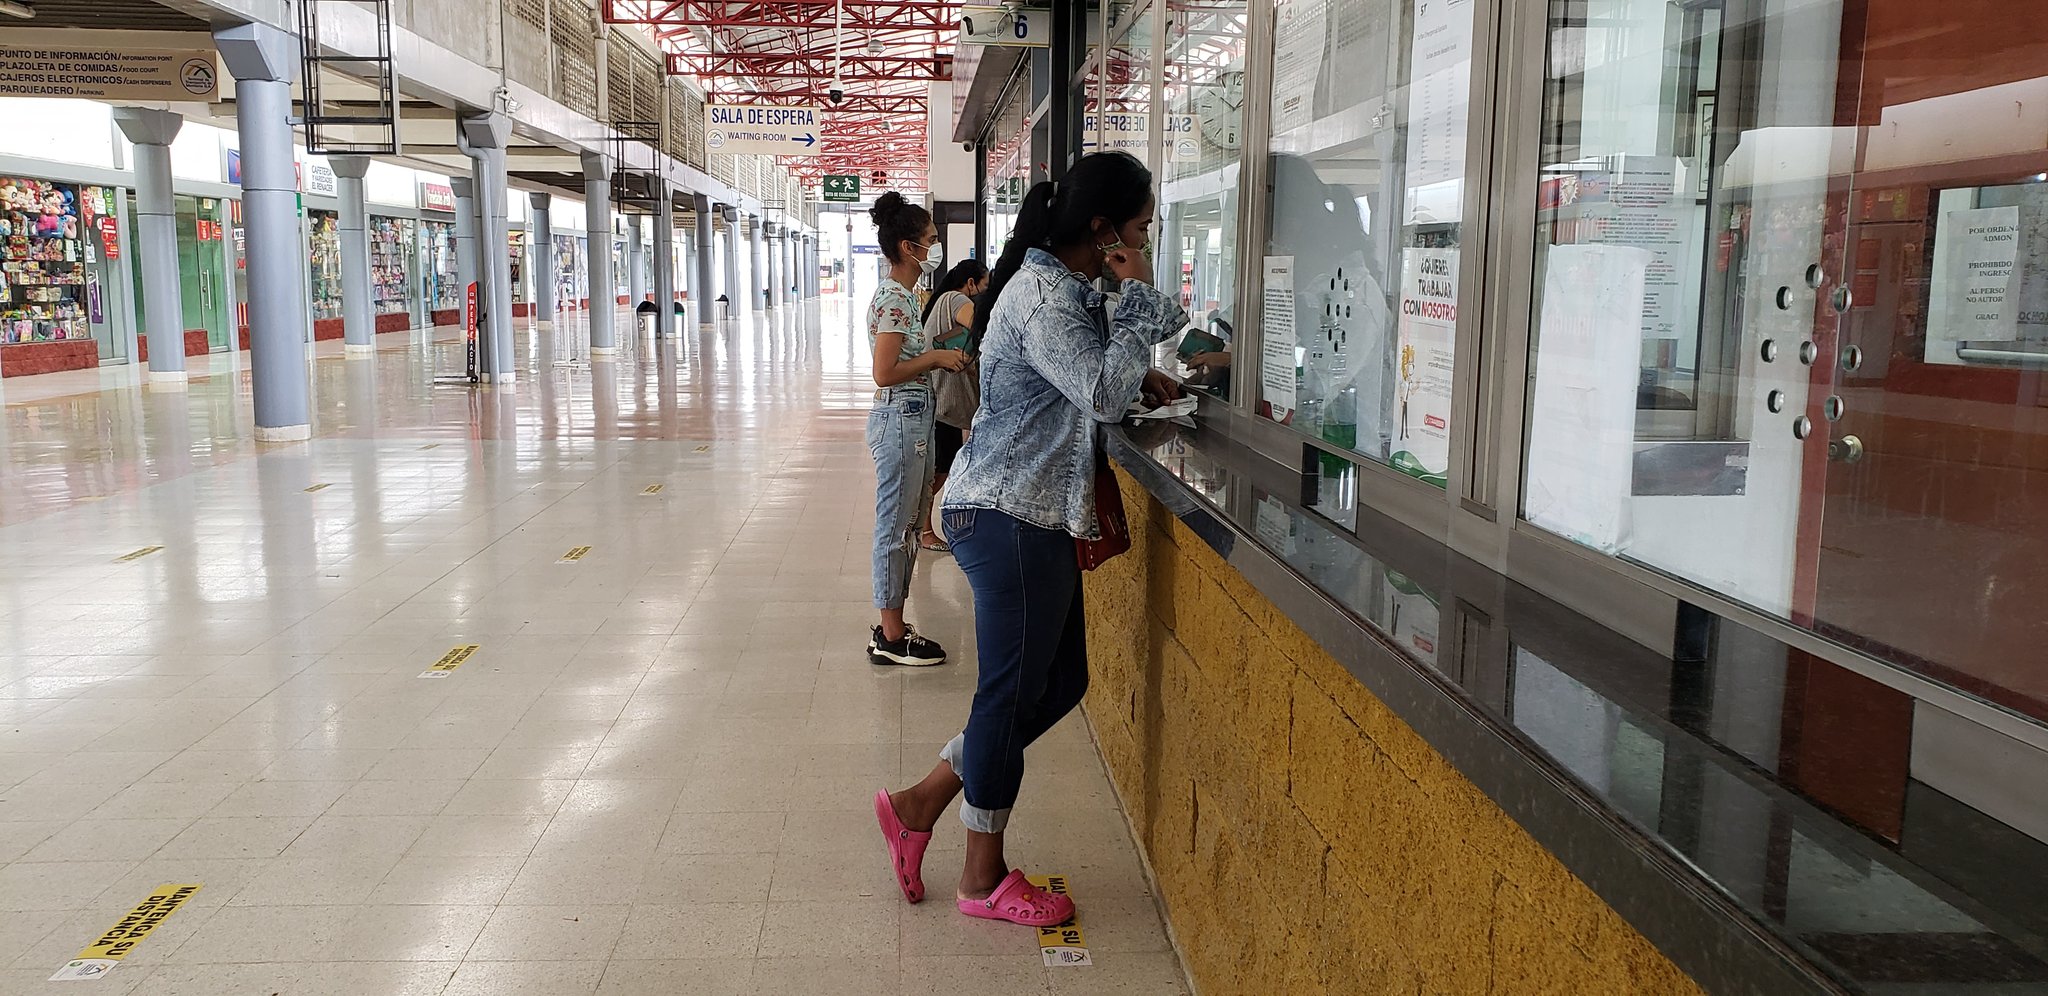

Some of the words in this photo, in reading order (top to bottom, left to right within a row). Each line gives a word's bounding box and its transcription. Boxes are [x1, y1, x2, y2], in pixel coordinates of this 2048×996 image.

[1014, 15, 1028, 39] 6
[0, 49, 32, 59] PUNTO
[34, 50, 48, 60] DE
[0, 61, 56, 71] PLAZOLETA
[58, 62, 72, 72] DE
[0, 72, 45, 82] CAJEROS
[0, 84, 74, 95] PARQUEADERO
[711, 107, 744, 125] SALA
[748, 108, 764, 125] DE
[766, 109, 814, 126] ESPERA
[727, 131, 760, 141] WAITING
[762, 133, 787, 142] ROOM
[1228, 132, 1235, 144] 6
[1968, 227, 1985, 235] POR
[1986, 225, 2015, 233] ORDEN
[1968, 260, 2012, 269] PROHIBIDO
[1418, 278, 1453, 299] TRABAJAR
[1969, 287, 1979, 295] AL
[1980, 287, 2005, 295] PERSO
[1403, 299, 1421, 317] CON
[1421, 301, 1456, 322] NOSOTRO
[2018, 311, 2048, 321] OCHO
[124, 886, 198, 939] MANTENGA
[93, 895, 167, 947] DISTANCIA
[1061, 929, 1081, 944] SU
[105, 941, 135, 956] SU
